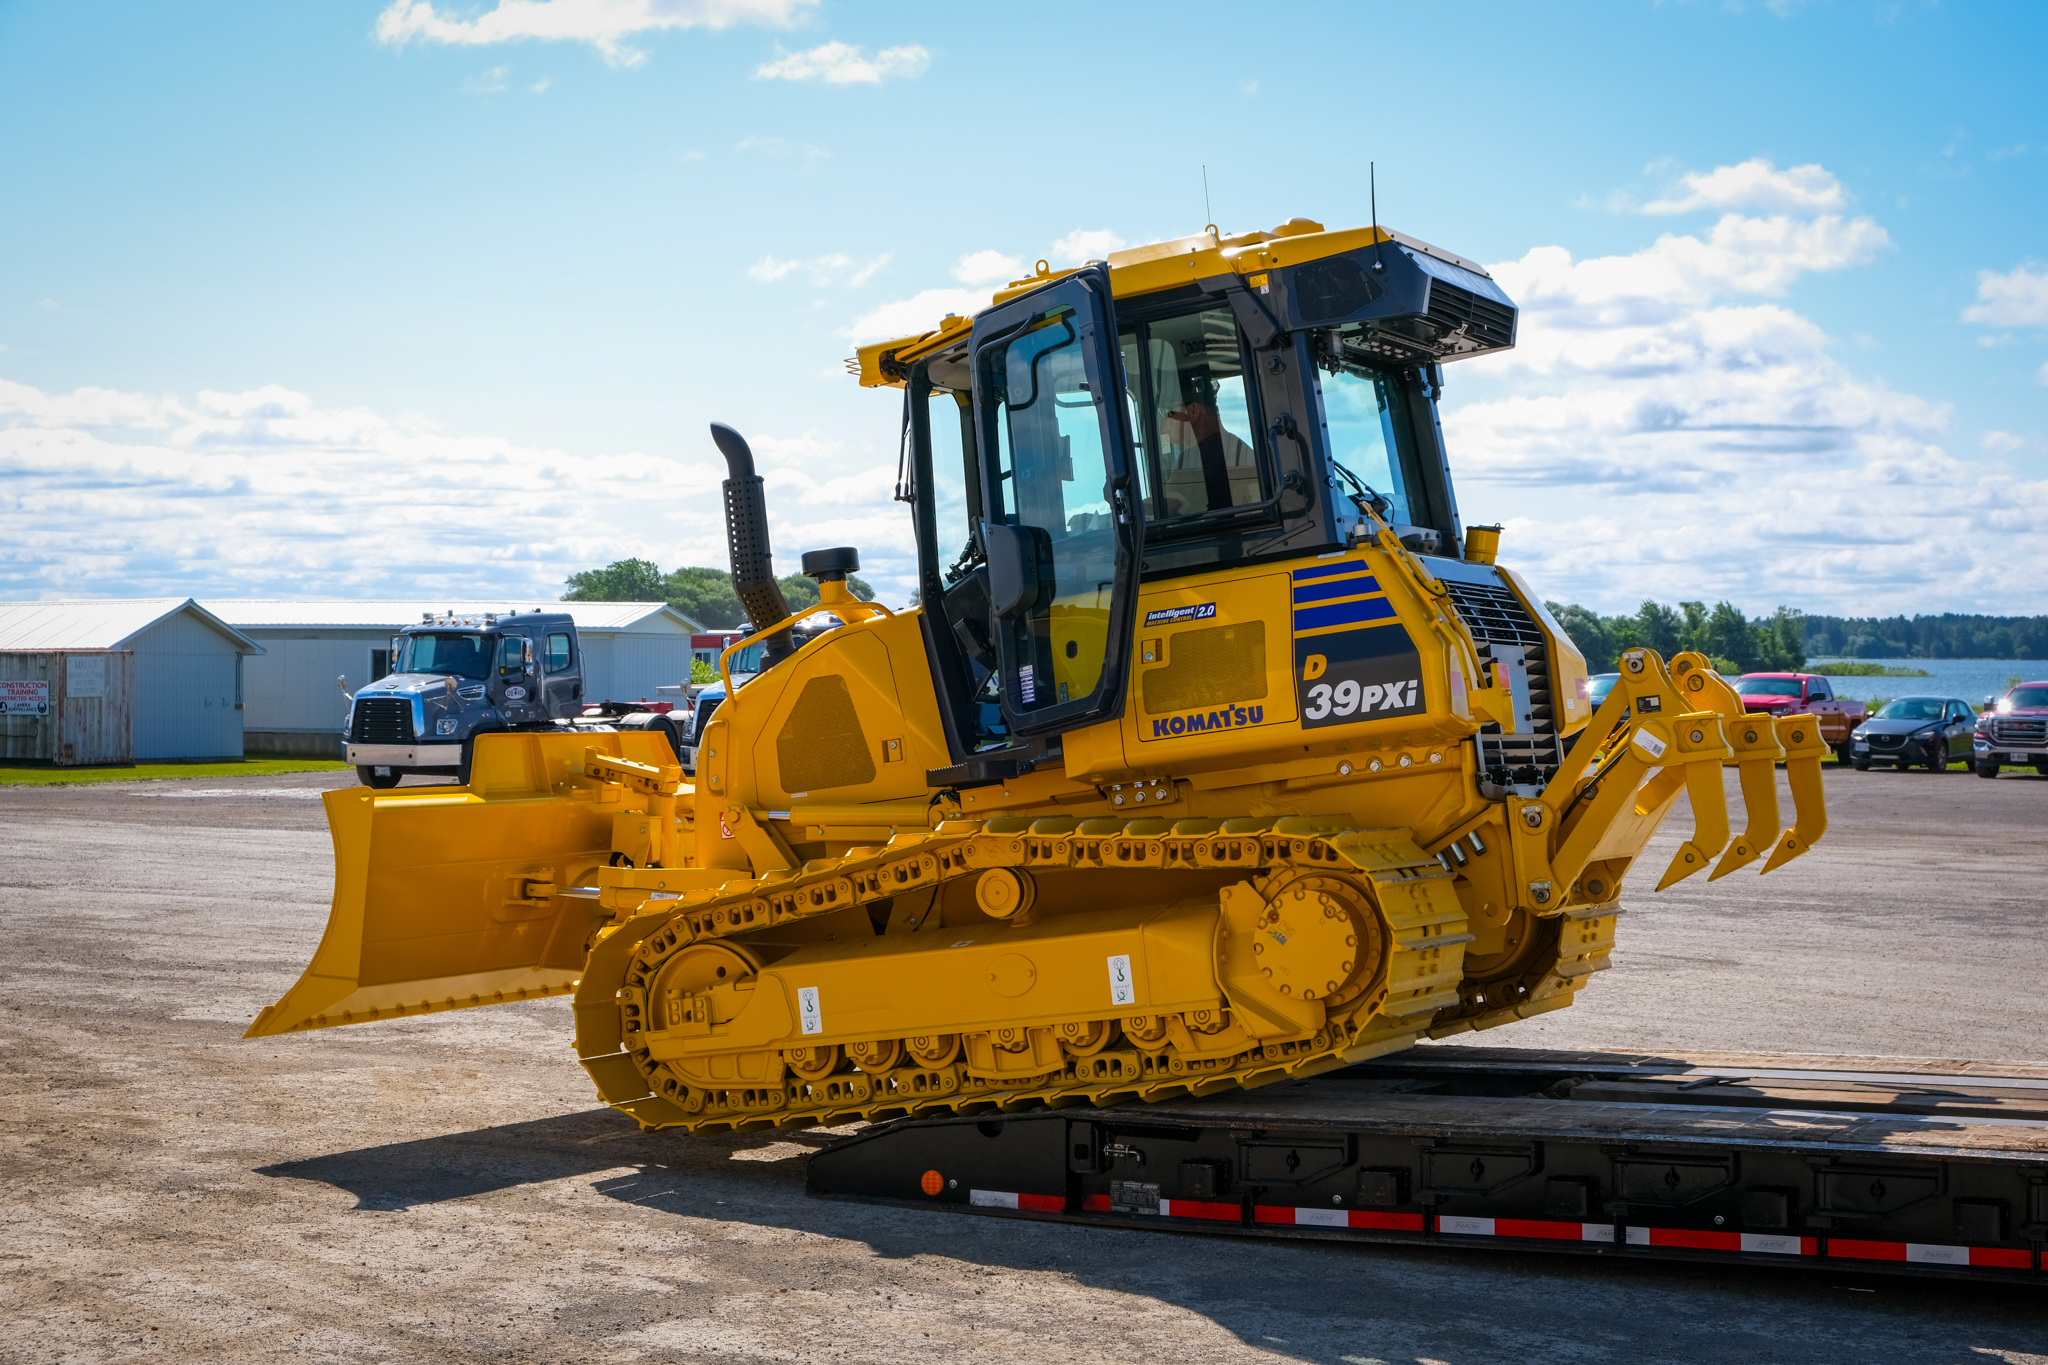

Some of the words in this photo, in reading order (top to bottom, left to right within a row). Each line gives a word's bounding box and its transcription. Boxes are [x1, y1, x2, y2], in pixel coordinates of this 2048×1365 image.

[1196, 604, 1215, 618] 2.0
[1146, 618, 1169, 627] MACHINE
[1169, 615, 1193, 623] CONTROL
[1153, 704, 1264, 737] KOMATSU
[1924, 1251, 1951, 1259] PARON
